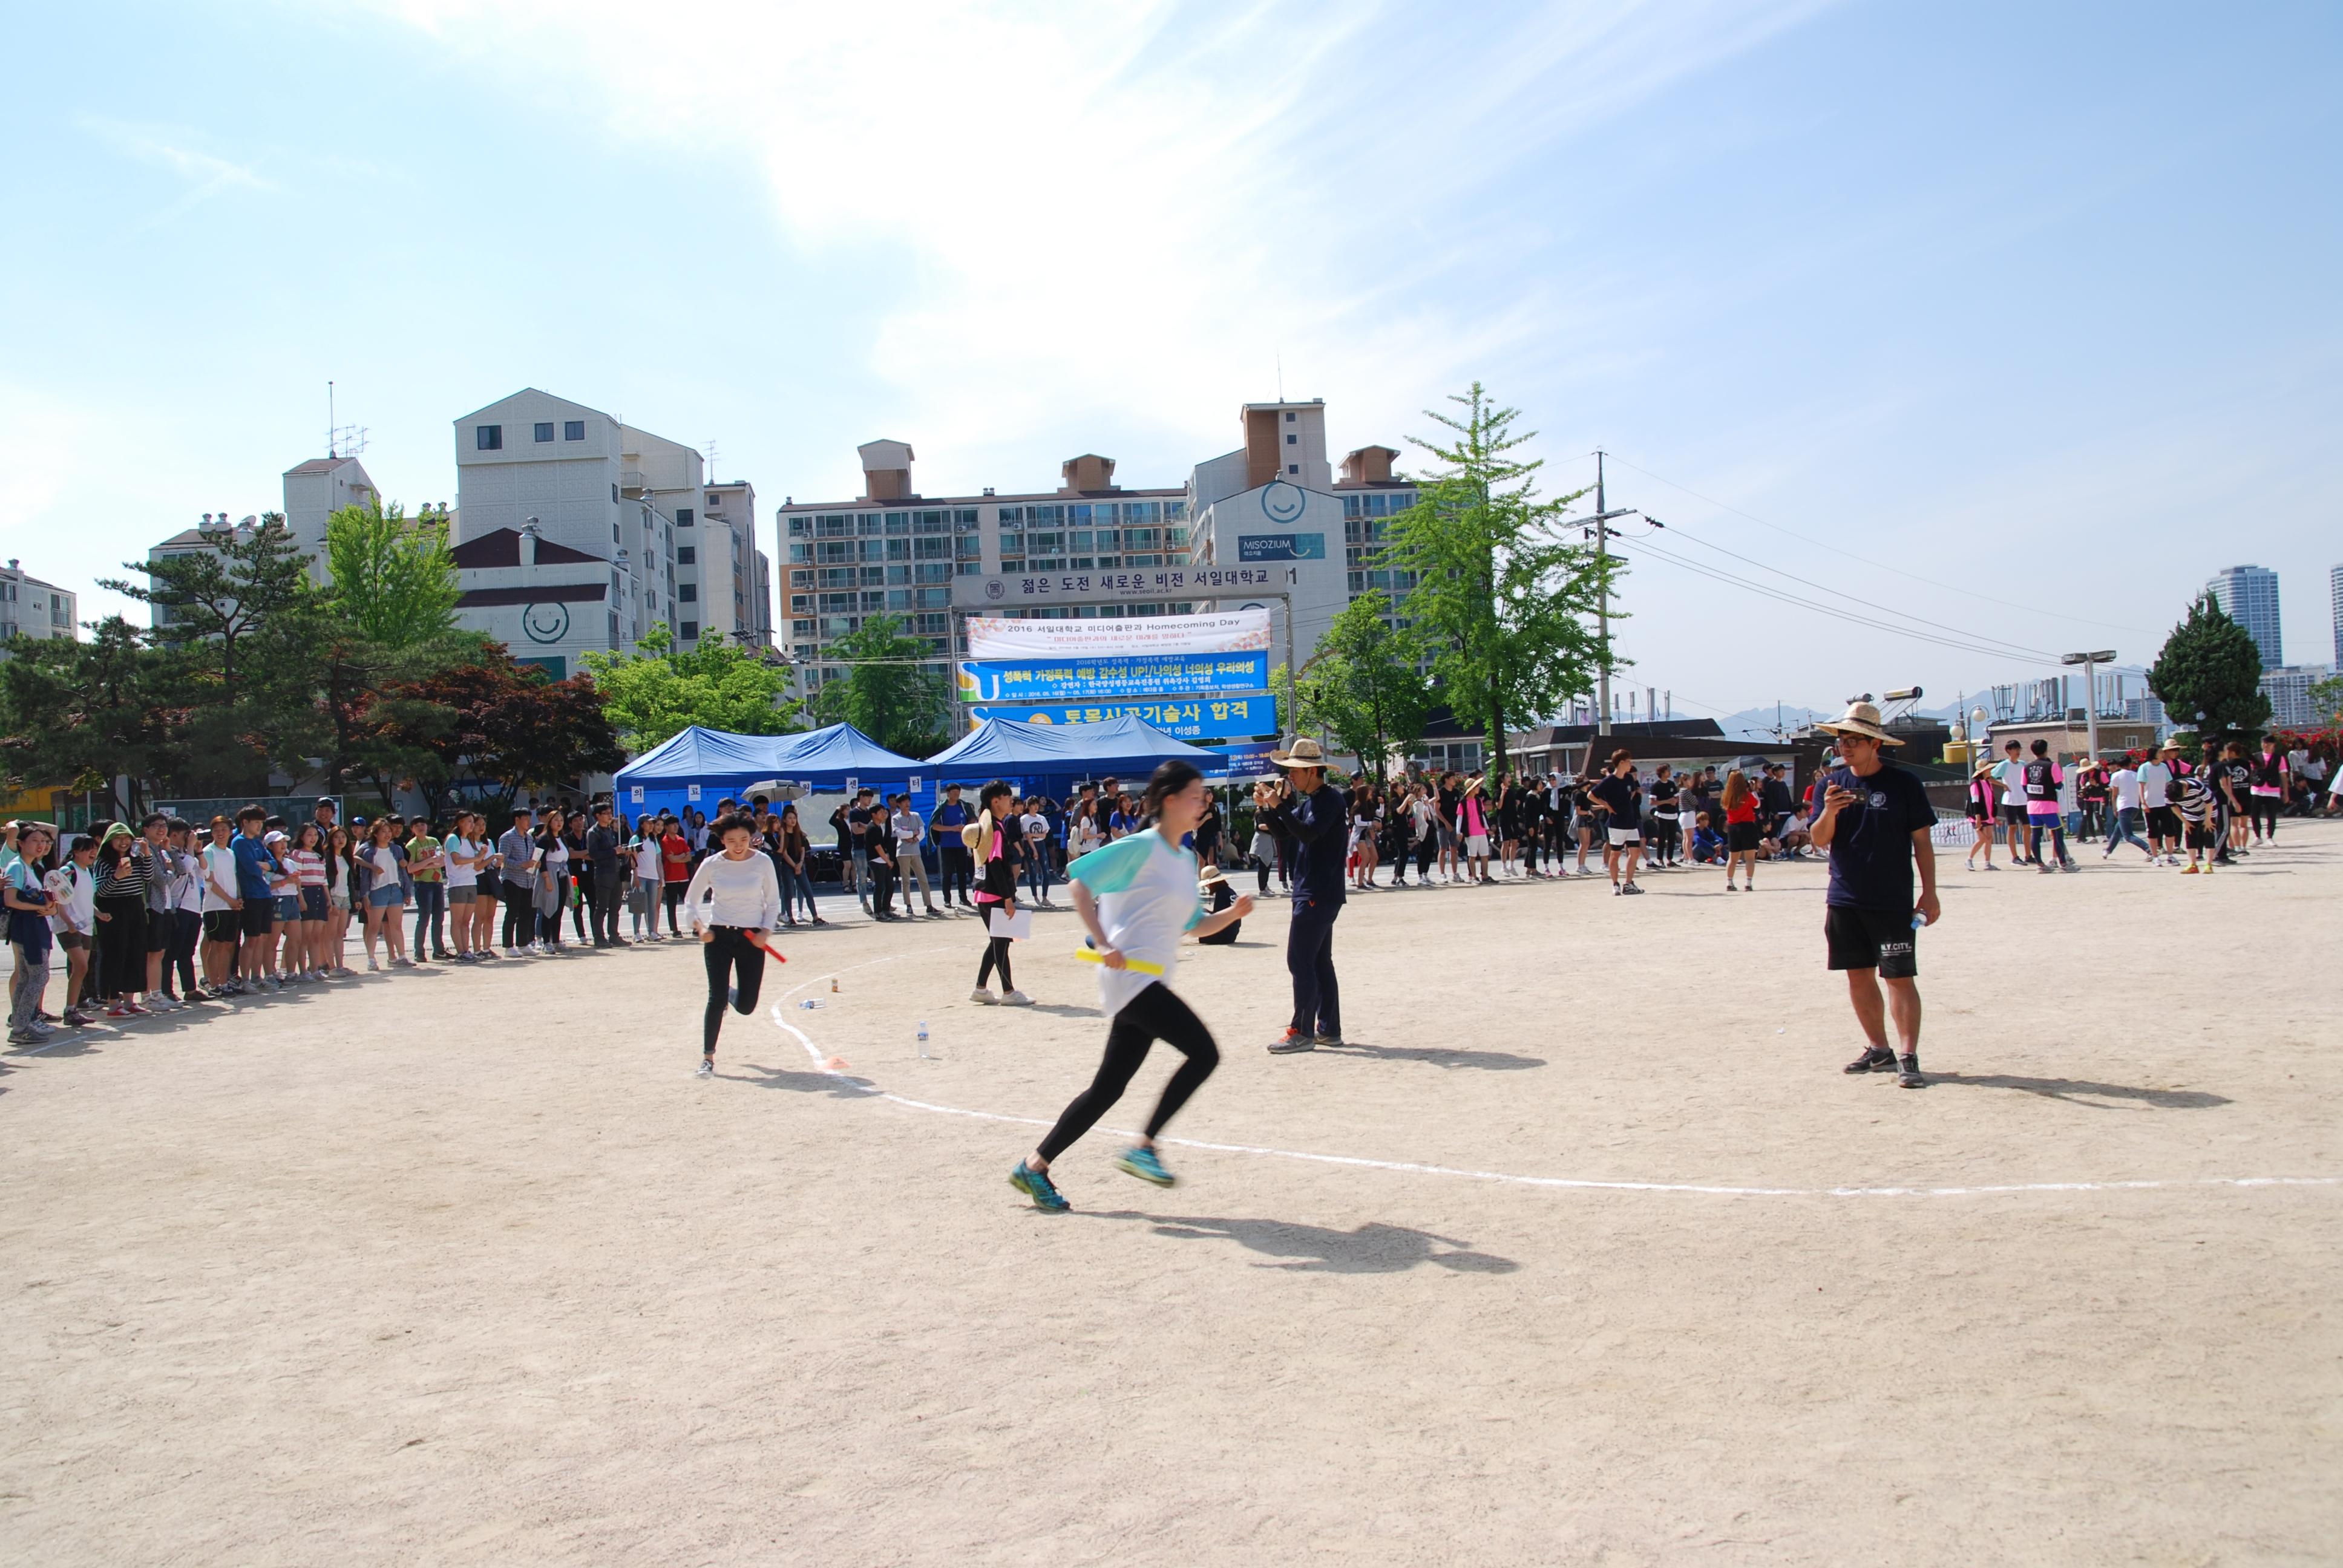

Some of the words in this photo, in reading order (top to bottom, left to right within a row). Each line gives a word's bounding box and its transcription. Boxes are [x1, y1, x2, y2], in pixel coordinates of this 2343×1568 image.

[1244, 540, 1291, 550] MISOZIUM
[1021, 578, 1051, 594] 젊은
[1061, 576, 1089, 592] 도전
[1101, 574, 1145, 590] 새로운
[1156, 572, 1184, 588] 비전
[1194, 569, 1269, 586] 서일대학교
[1286, 567, 1297, 584] 1
[1088, 624, 1142, 633] 미디어출판과
[1147, 621, 1215, 630] Homecoming
[1003, 670, 1032, 684] 성폭력
[1035, 668, 1073, 682] 가정폭력
[1076, 667, 1096, 680] 예방
[1099, 666, 1128, 679] 감수성
[1185, 663, 1213, 676] 너의성
[1216, 661, 1254, 675] 우리의성
[1210, 701, 1248, 720] 합격
[634, 788, 642, 798] 의
[913, 778, 919, 787] 터
